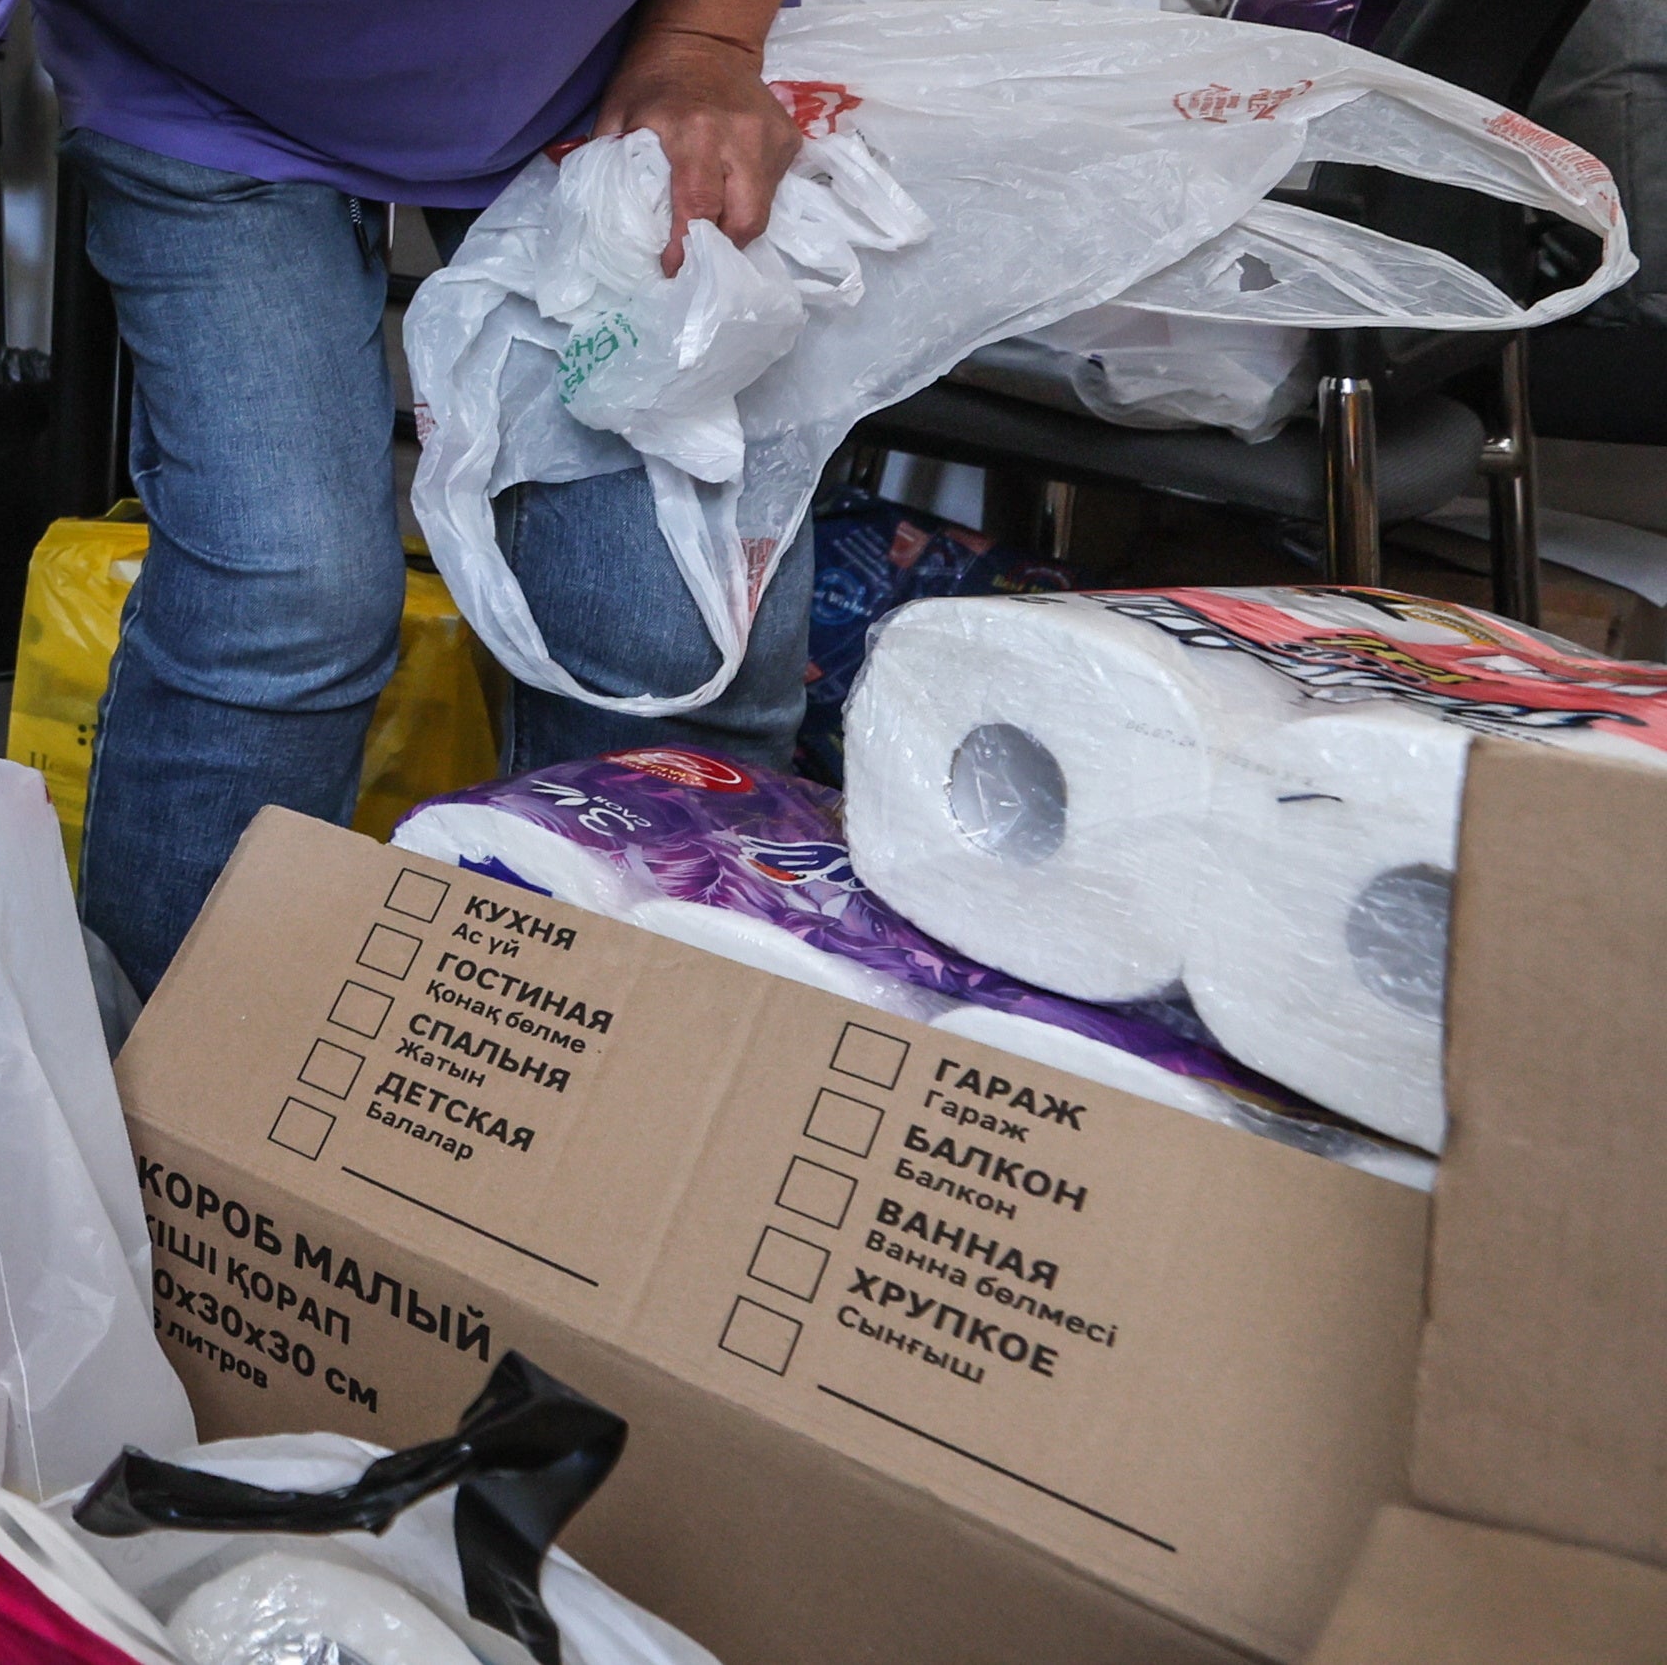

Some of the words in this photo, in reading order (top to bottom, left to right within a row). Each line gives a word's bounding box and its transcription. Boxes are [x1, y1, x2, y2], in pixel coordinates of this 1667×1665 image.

[591, 794, 653, 829] СЛОЯ
[451, 922, 483, 944] Ас
[464, 894, 578, 952] КУХНЯ
[425, 979, 502, 1025] Қонақ
[504, 1010, 587, 1054] бөлме
[436, 951, 614, 1035] ГОСТИНАЯ
[394, 1036, 487, 1088] Жатын
[408, 1013, 571, 1093] СПАЛЬНЯ
[365, 1100, 474, 1162] Балалар
[374, 1071, 536, 1153] ДЕТСКАЯ
[923, 1089, 1031, 1144] Гараж
[934, 1057, 1088, 1131] ГАРАЖ
[893, 1157, 1018, 1221] Балкон
[902, 1124, 1088, 1213] БАЛКОН
[138, 1154, 283, 1257] КОРОБ
[293, 1232, 492, 1364] МАЛЫЙ
[875, 1197, 1061, 1291] ВАННАЯ
[226, 1256, 352, 1345] ҚОРАП
[847, 1266, 1061, 1378] ХРУПКОЕ
[864, 1228, 967, 1288] Ванна
[974, 1273, 1120, 1348] бөлмесі
[167, 1320, 269, 1390] литров
[836, 1304, 986, 1385] Сынғыш
